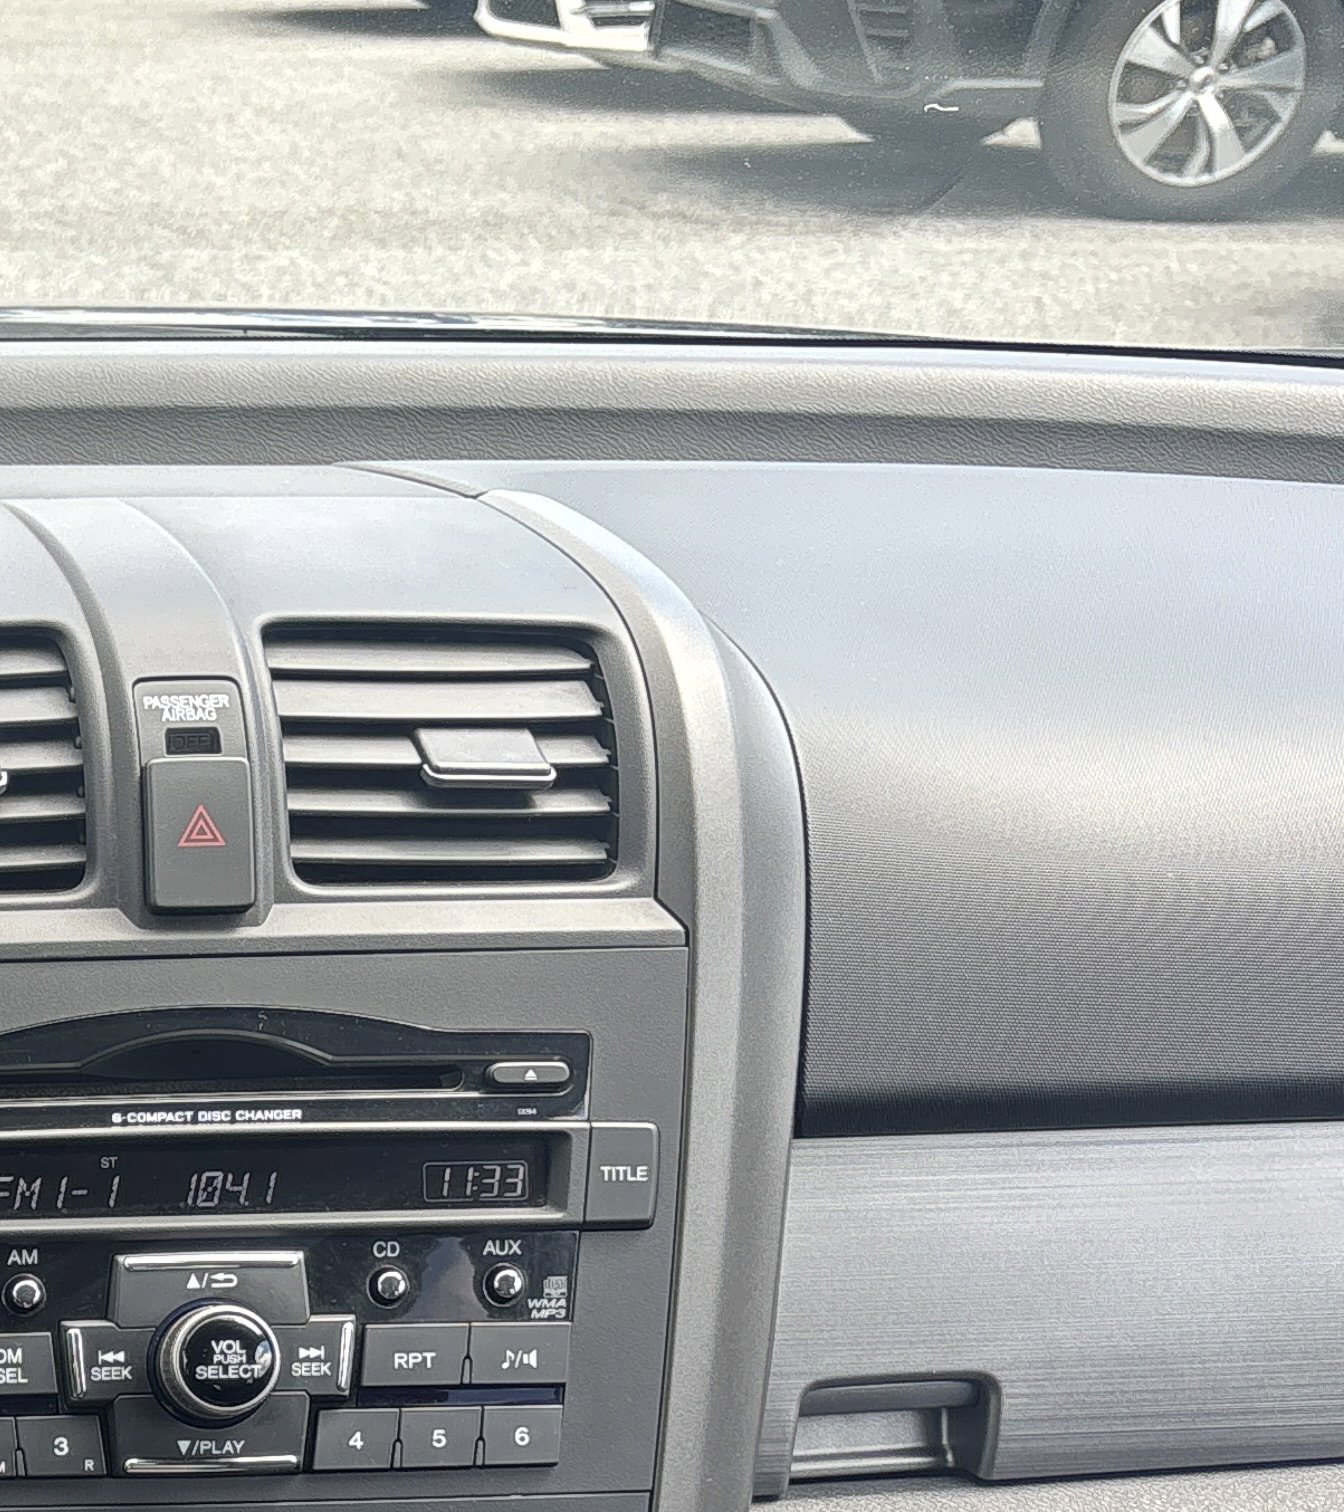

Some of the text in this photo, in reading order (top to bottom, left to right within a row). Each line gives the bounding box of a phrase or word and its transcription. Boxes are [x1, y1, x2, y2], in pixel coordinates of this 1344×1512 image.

[143, 694, 230, 709] PASSENGER
[161, 708, 217, 722] AIRBAG
[173, 734, 210, 750] OFF
[198, 1109, 231, 1122] DISC
[235, 1108, 303, 1121] CHANGER
[100, 1157, 118, 1168] ST
[440, 1164, 525, 1198] 11:33
[599, 1166, 648, 1182] TITLE
[373, 1242, 400, 1257] CD
[483, 1240, 521, 1256] AUX
[7, 1249, 38, 1265] AM
[527, 1298, 567, 1309] WMA
[531, 1309, 566, 1319] MP3
[211, 1340, 246, 1354] VOL
[213, 1354, 246, 1364] PUSH
[394, 1352, 436, 1368] RPT
[90, 1367, 132, 1381] SEEK
[195, 1365, 262, 1379] SELECT
[291, 1362, 332, 1377] SEEK
[348, 1431, 364, 1449] 4
[432, 1429, 447, 1447] 5
[515, 1427, 530, 1445] 6
[53, 1437, 69, 1455] 3
[84, 1460, 94, 1471] R
